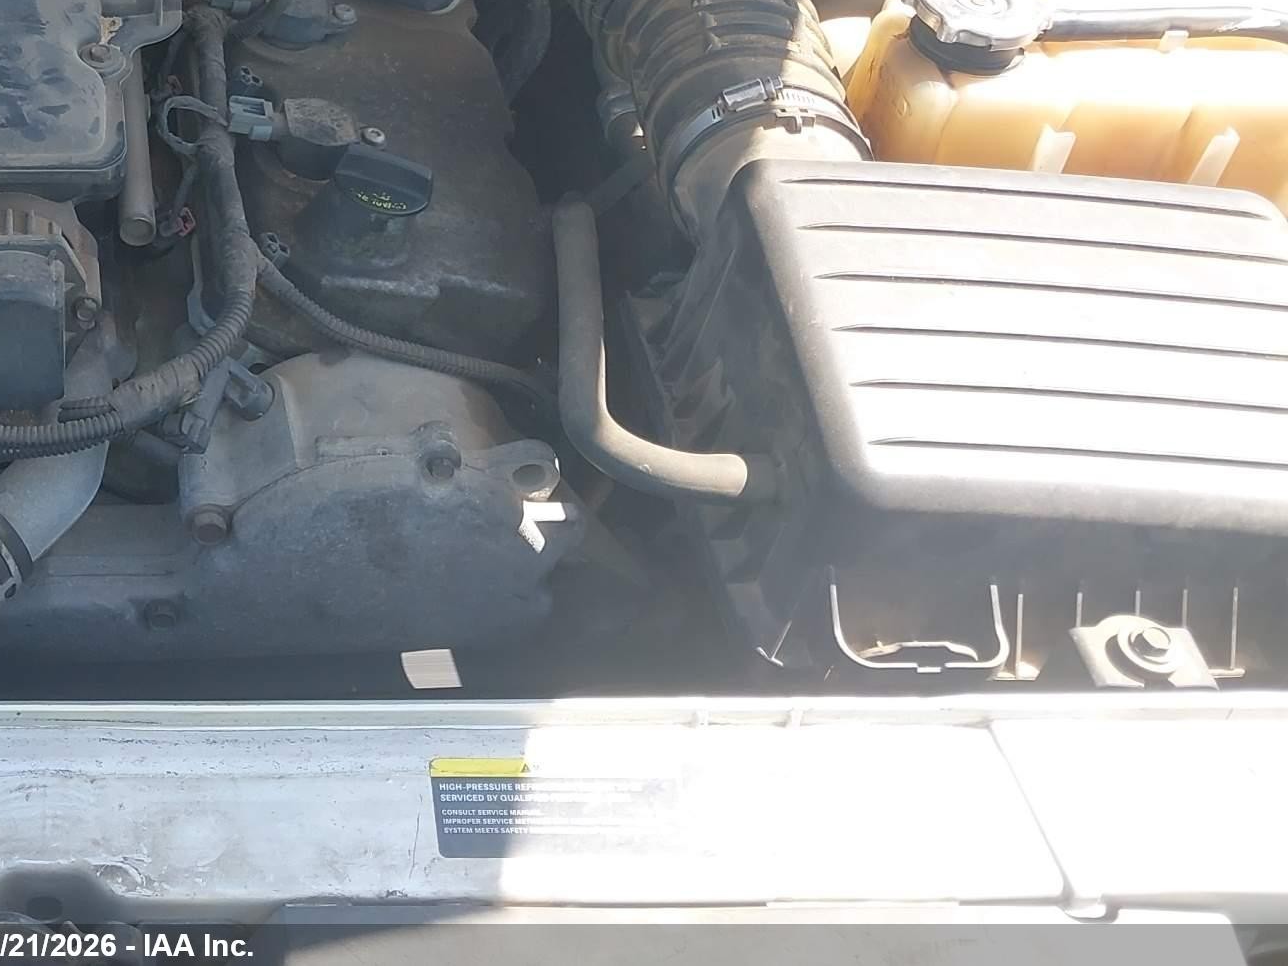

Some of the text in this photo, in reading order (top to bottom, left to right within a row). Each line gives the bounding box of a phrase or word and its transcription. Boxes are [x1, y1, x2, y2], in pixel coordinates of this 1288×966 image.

[439, 783, 513, 791] HIGH-PRESSURE
[440, 794, 483, 802] SERVICED
[487, 794, 498, 802] BY
